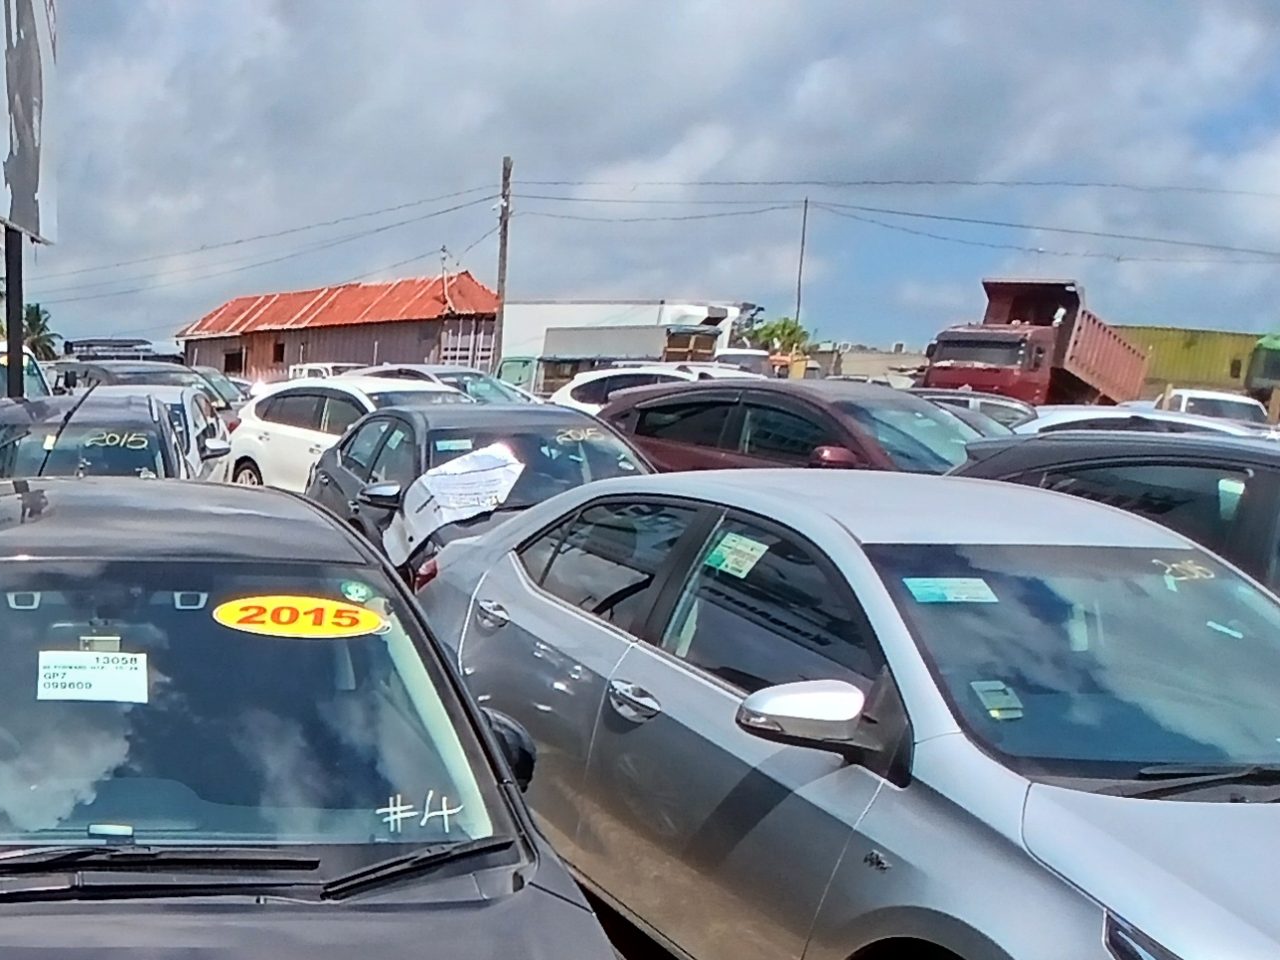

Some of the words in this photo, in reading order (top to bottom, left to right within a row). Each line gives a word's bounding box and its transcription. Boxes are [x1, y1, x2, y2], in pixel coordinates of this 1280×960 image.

[83, 431, 149, 450] 2015
[237, 605, 360, 627] 2015
[375, 789, 464, 833] #4
